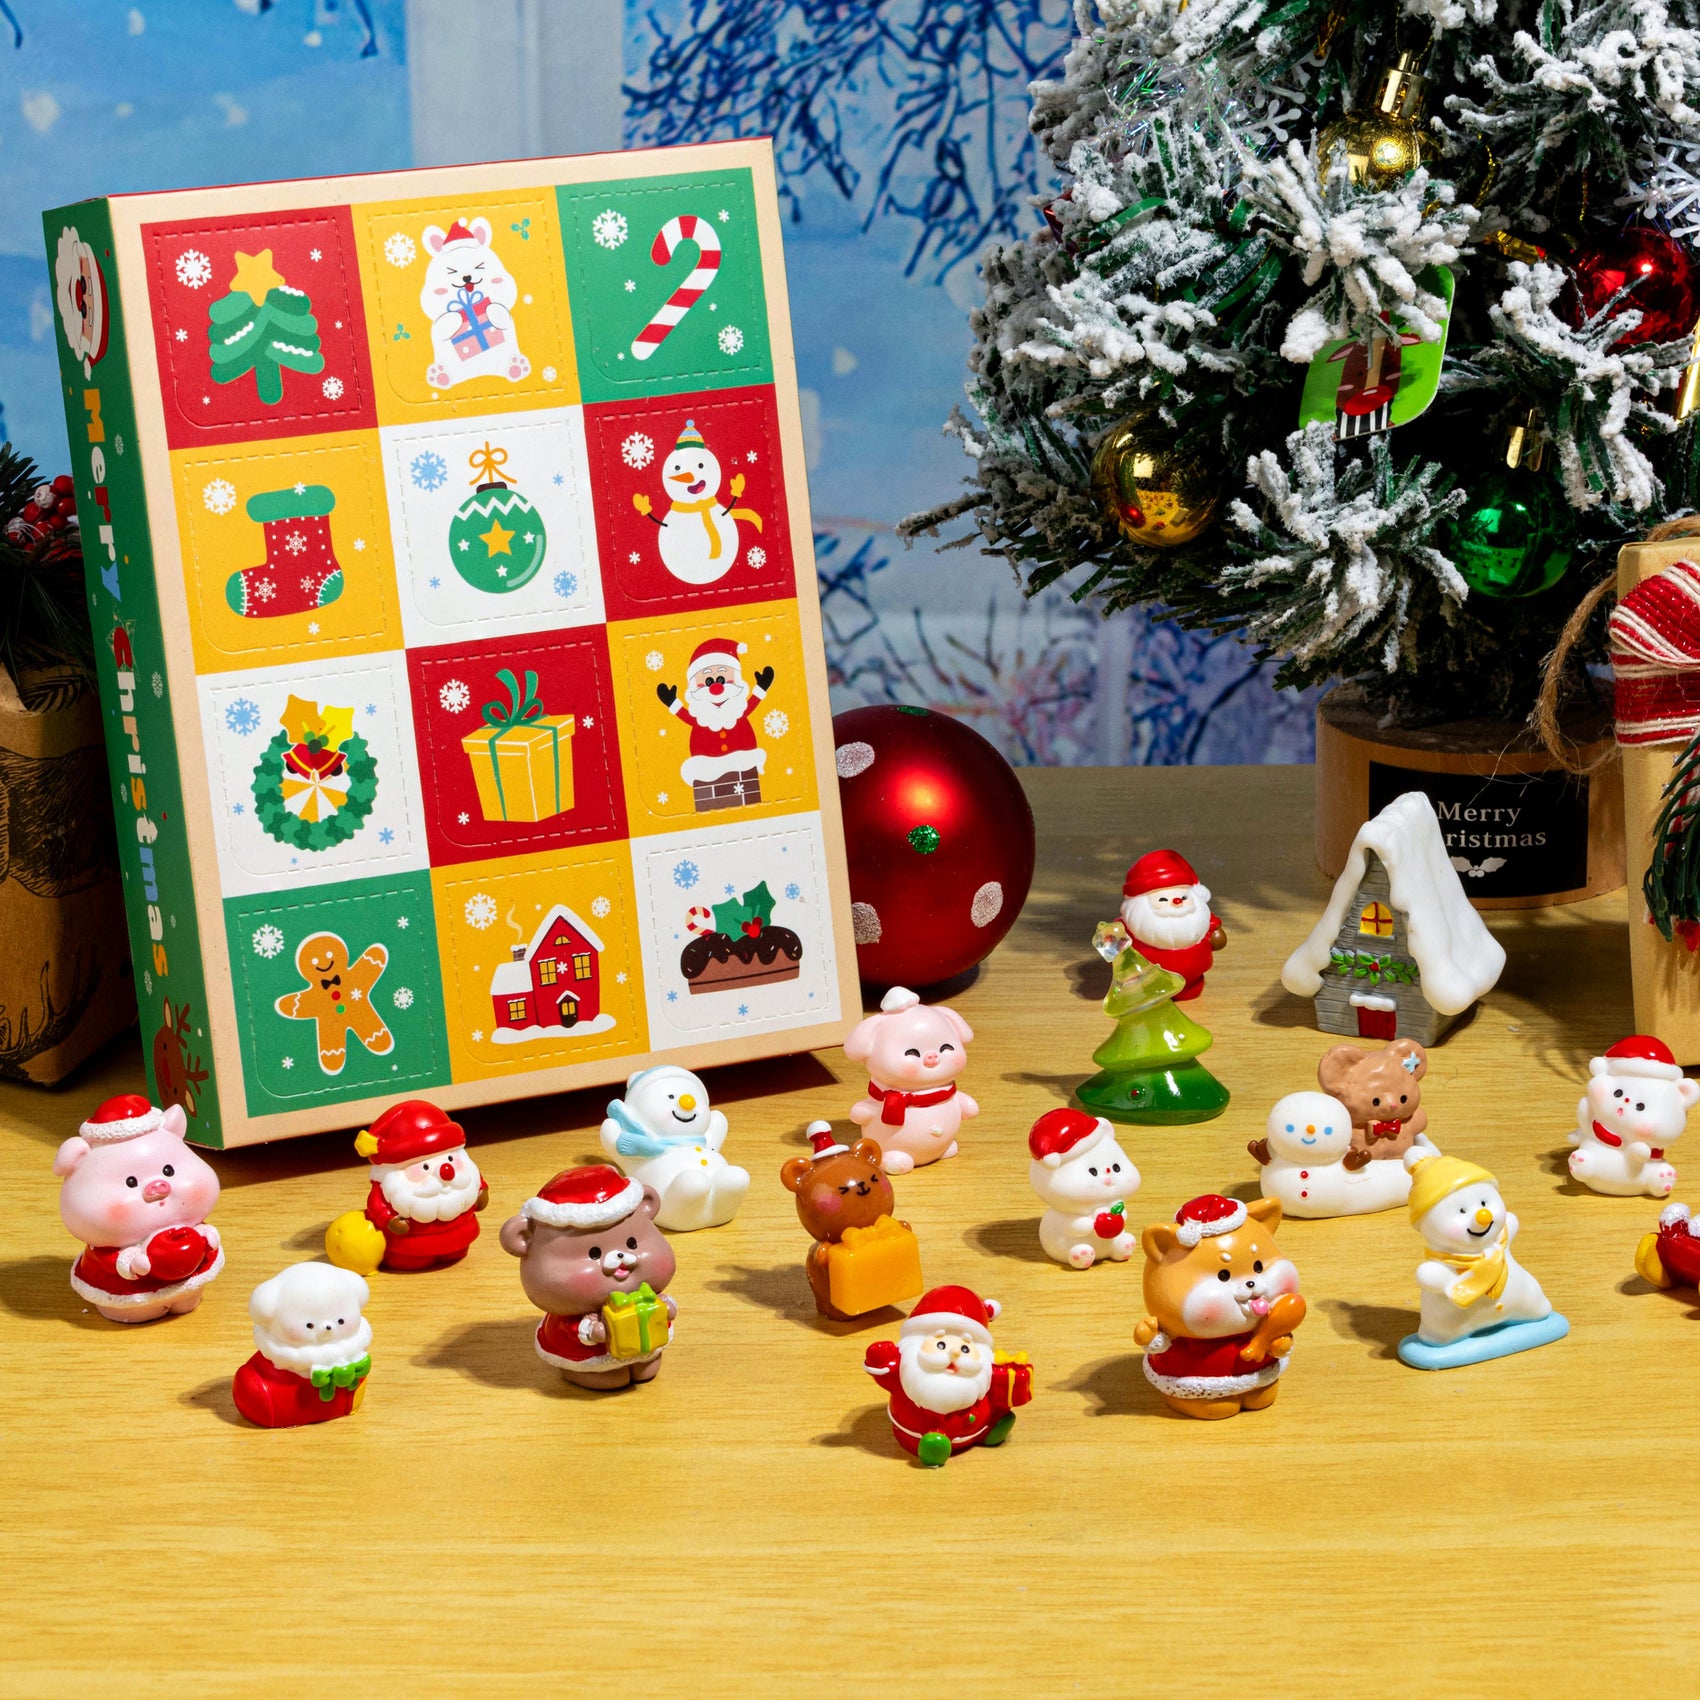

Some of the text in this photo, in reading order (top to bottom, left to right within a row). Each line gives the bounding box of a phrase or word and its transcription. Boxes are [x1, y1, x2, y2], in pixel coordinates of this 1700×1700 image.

[83, 388, 169, 976] Merry Christmas
[1438, 801, 1521, 827] Merry
[1446, 830, 1547, 848] ristmas
